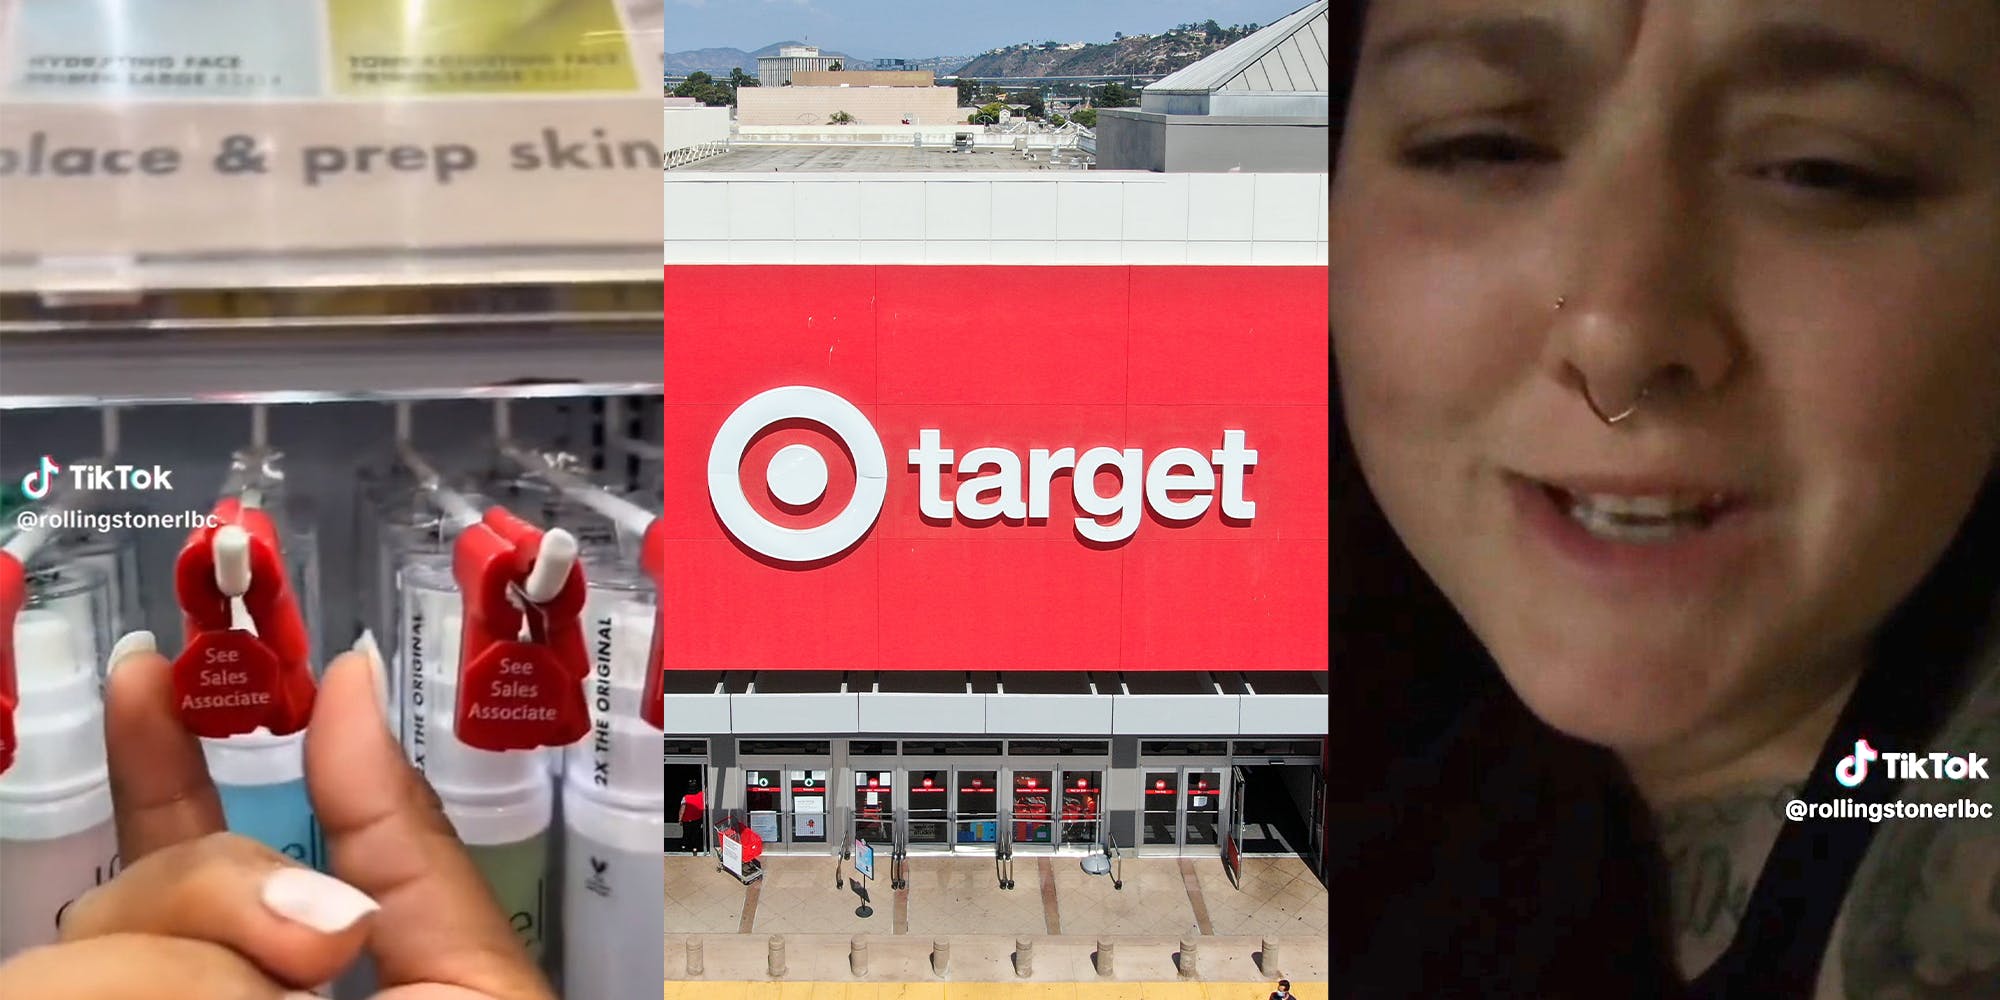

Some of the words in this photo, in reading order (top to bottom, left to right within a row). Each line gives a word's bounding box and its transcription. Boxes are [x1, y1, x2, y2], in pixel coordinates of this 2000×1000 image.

[213, 133, 271, 175] &
[303, 142, 478, 186] prep
[510, 127, 663, 171] skin
[908, 429, 1258, 543] target
[205, 647, 240, 664] See
[411, 613, 426, 708] ORIGINAL
[500, 657, 533, 675] See
[596, 616, 613, 712] ORIGINAL
[200, 669, 248, 686] Sales
[490, 680, 539, 698] Sales
[181, 691, 271, 711] Associate
[467, 702, 558, 721] Associate
[413, 715, 426, 748] THE
[594, 719, 611, 759] THE
[594, 762, 611, 786] 2X
